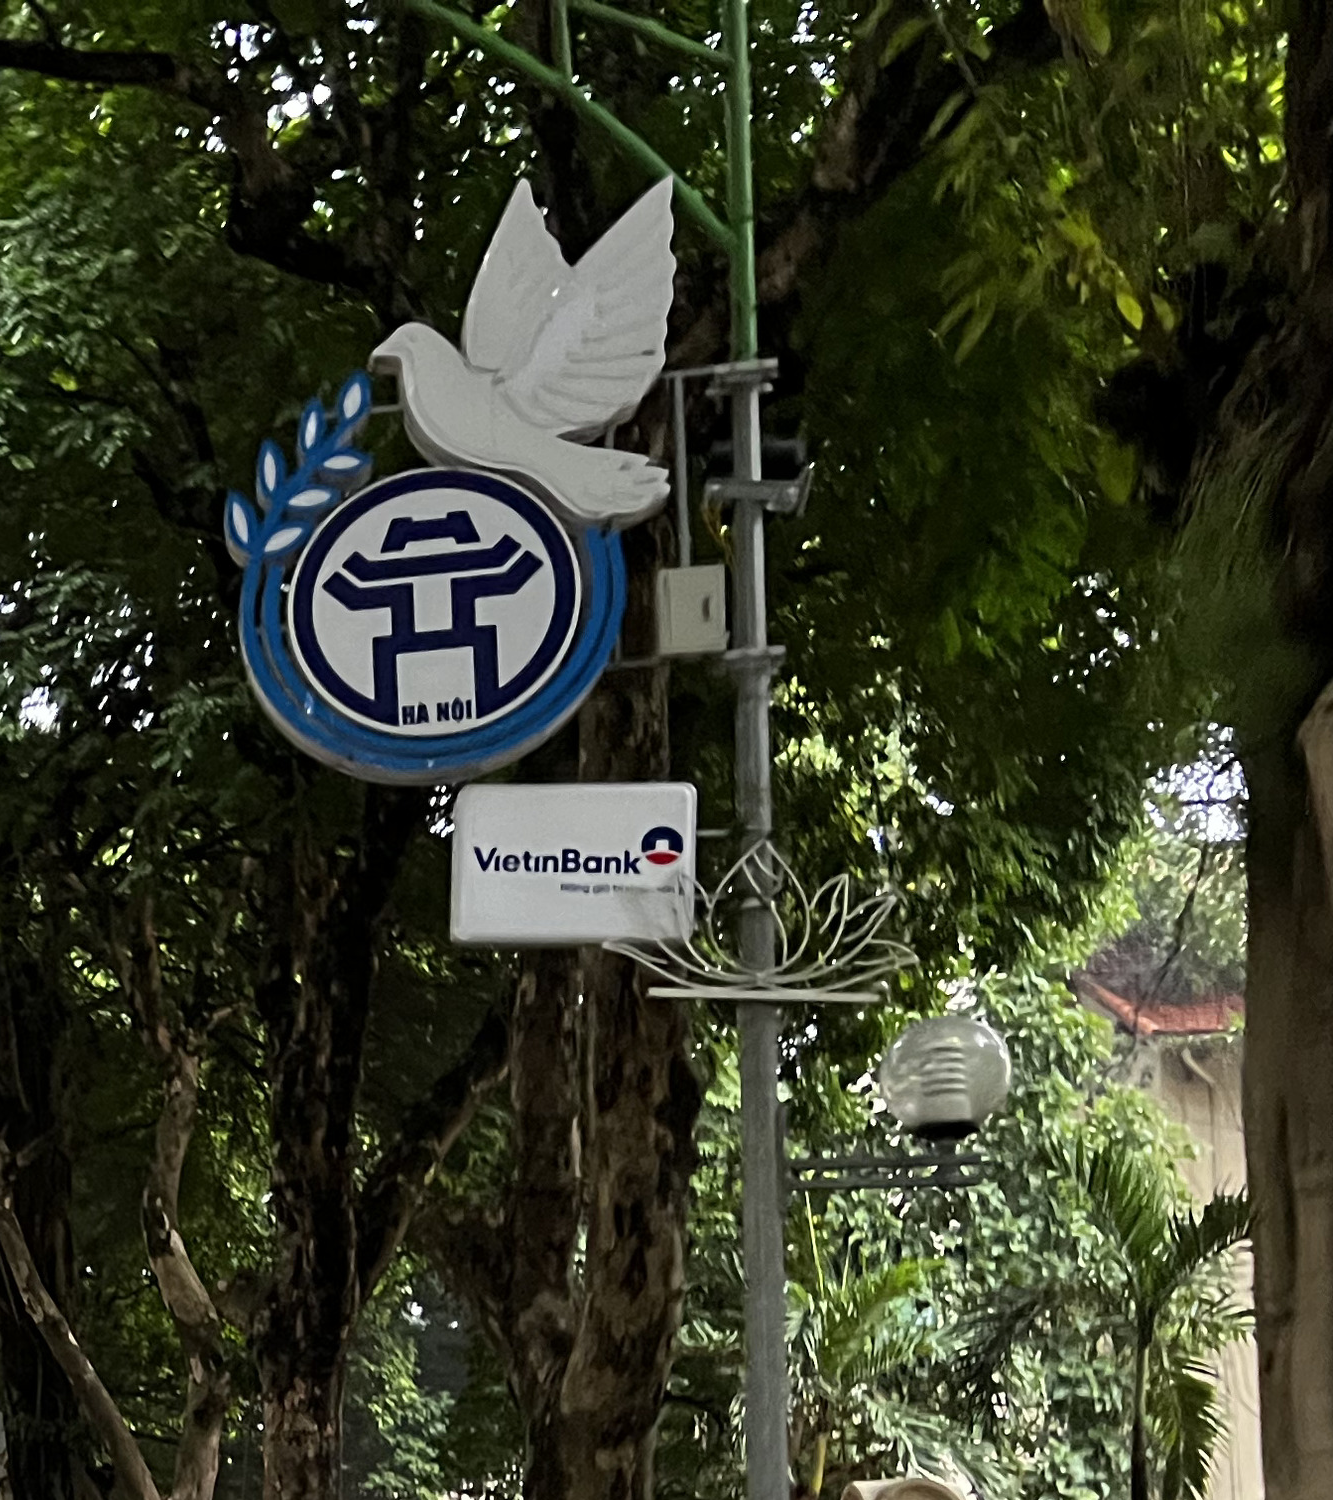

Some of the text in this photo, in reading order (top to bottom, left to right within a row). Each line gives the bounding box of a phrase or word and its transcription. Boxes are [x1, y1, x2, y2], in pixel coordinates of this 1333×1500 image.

[402, 696, 472, 725] HÀ NỘI
[473, 846, 641, 875] VietinBank
